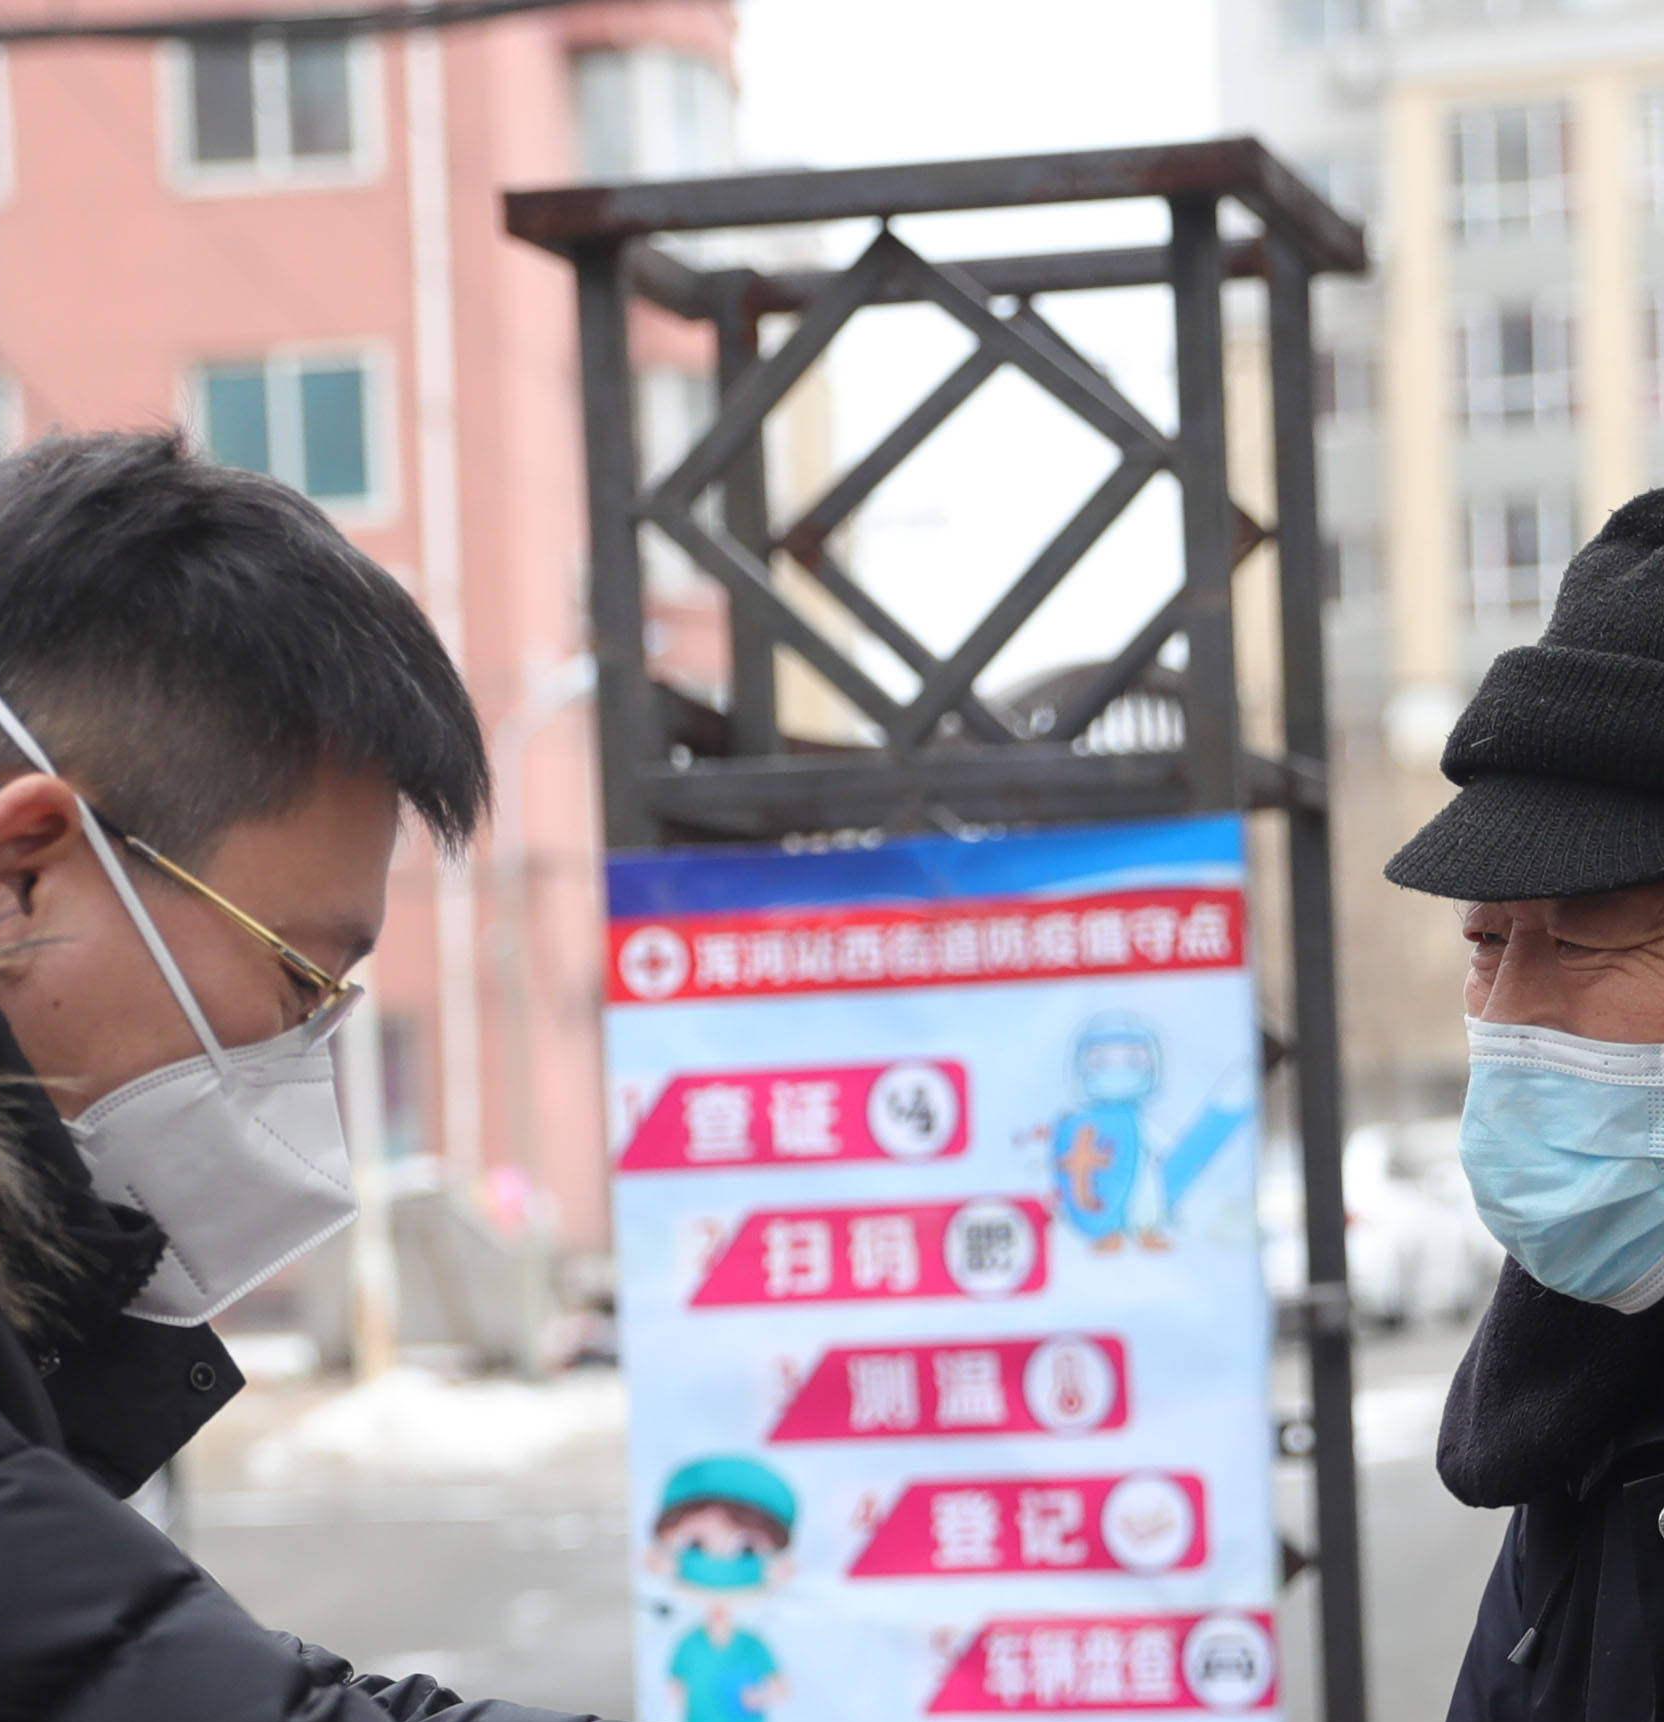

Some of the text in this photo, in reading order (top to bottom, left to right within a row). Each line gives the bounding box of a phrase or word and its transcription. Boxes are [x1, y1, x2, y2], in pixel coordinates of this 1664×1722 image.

[682, 1077, 844, 1163] 查证
[759, 1214, 924, 1300] 扫码
[845, 1349, 1009, 1432] 测温
[928, 1488, 1089, 1570] 登记
